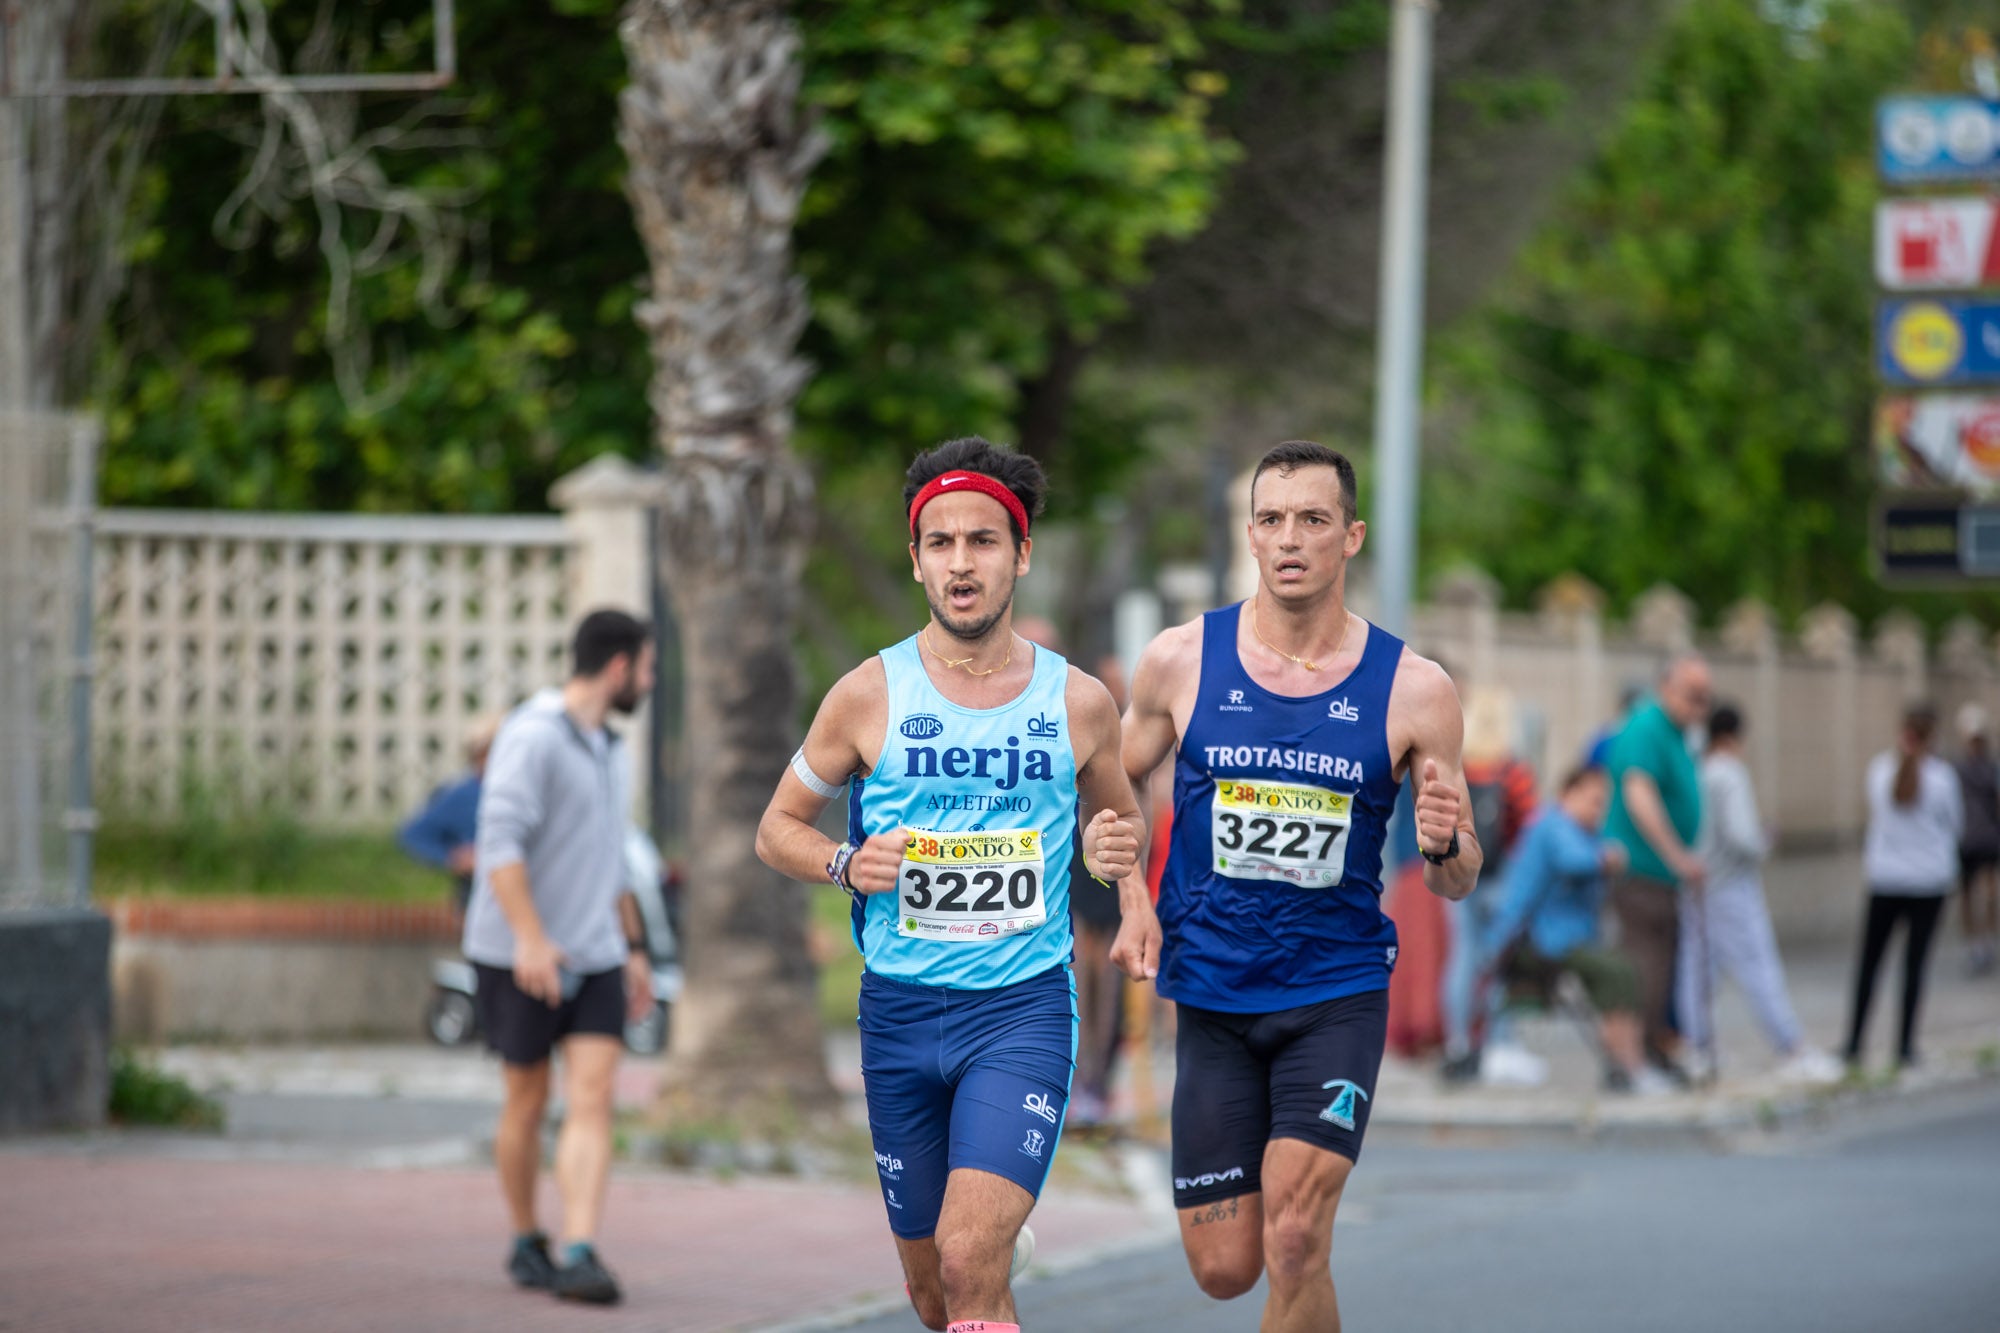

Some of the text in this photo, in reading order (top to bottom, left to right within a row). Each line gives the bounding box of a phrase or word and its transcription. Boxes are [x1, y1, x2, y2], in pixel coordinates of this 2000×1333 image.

[902, 718, 941, 736] TROPS
[904, 736, 1055, 790] nerja
[1205, 746, 1363, 783] TROTASIERRA
[1234, 786, 1255, 802] 38
[1260, 786, 1282, 795] GRAN
[1285, 789, 1317, 799] PREMIO
[926, 794, 1031, 813] ATLETISMO
[1256, 793, 1322, 811] FONDO
[972, 836, 1007, 844] PREMIO
[1218, 813, 1345, 860] 3227
[918, 837, 939, 857] 38
[939, 843, 1014, 859] FONDO
[904, 868, 1037, 912] 3220
